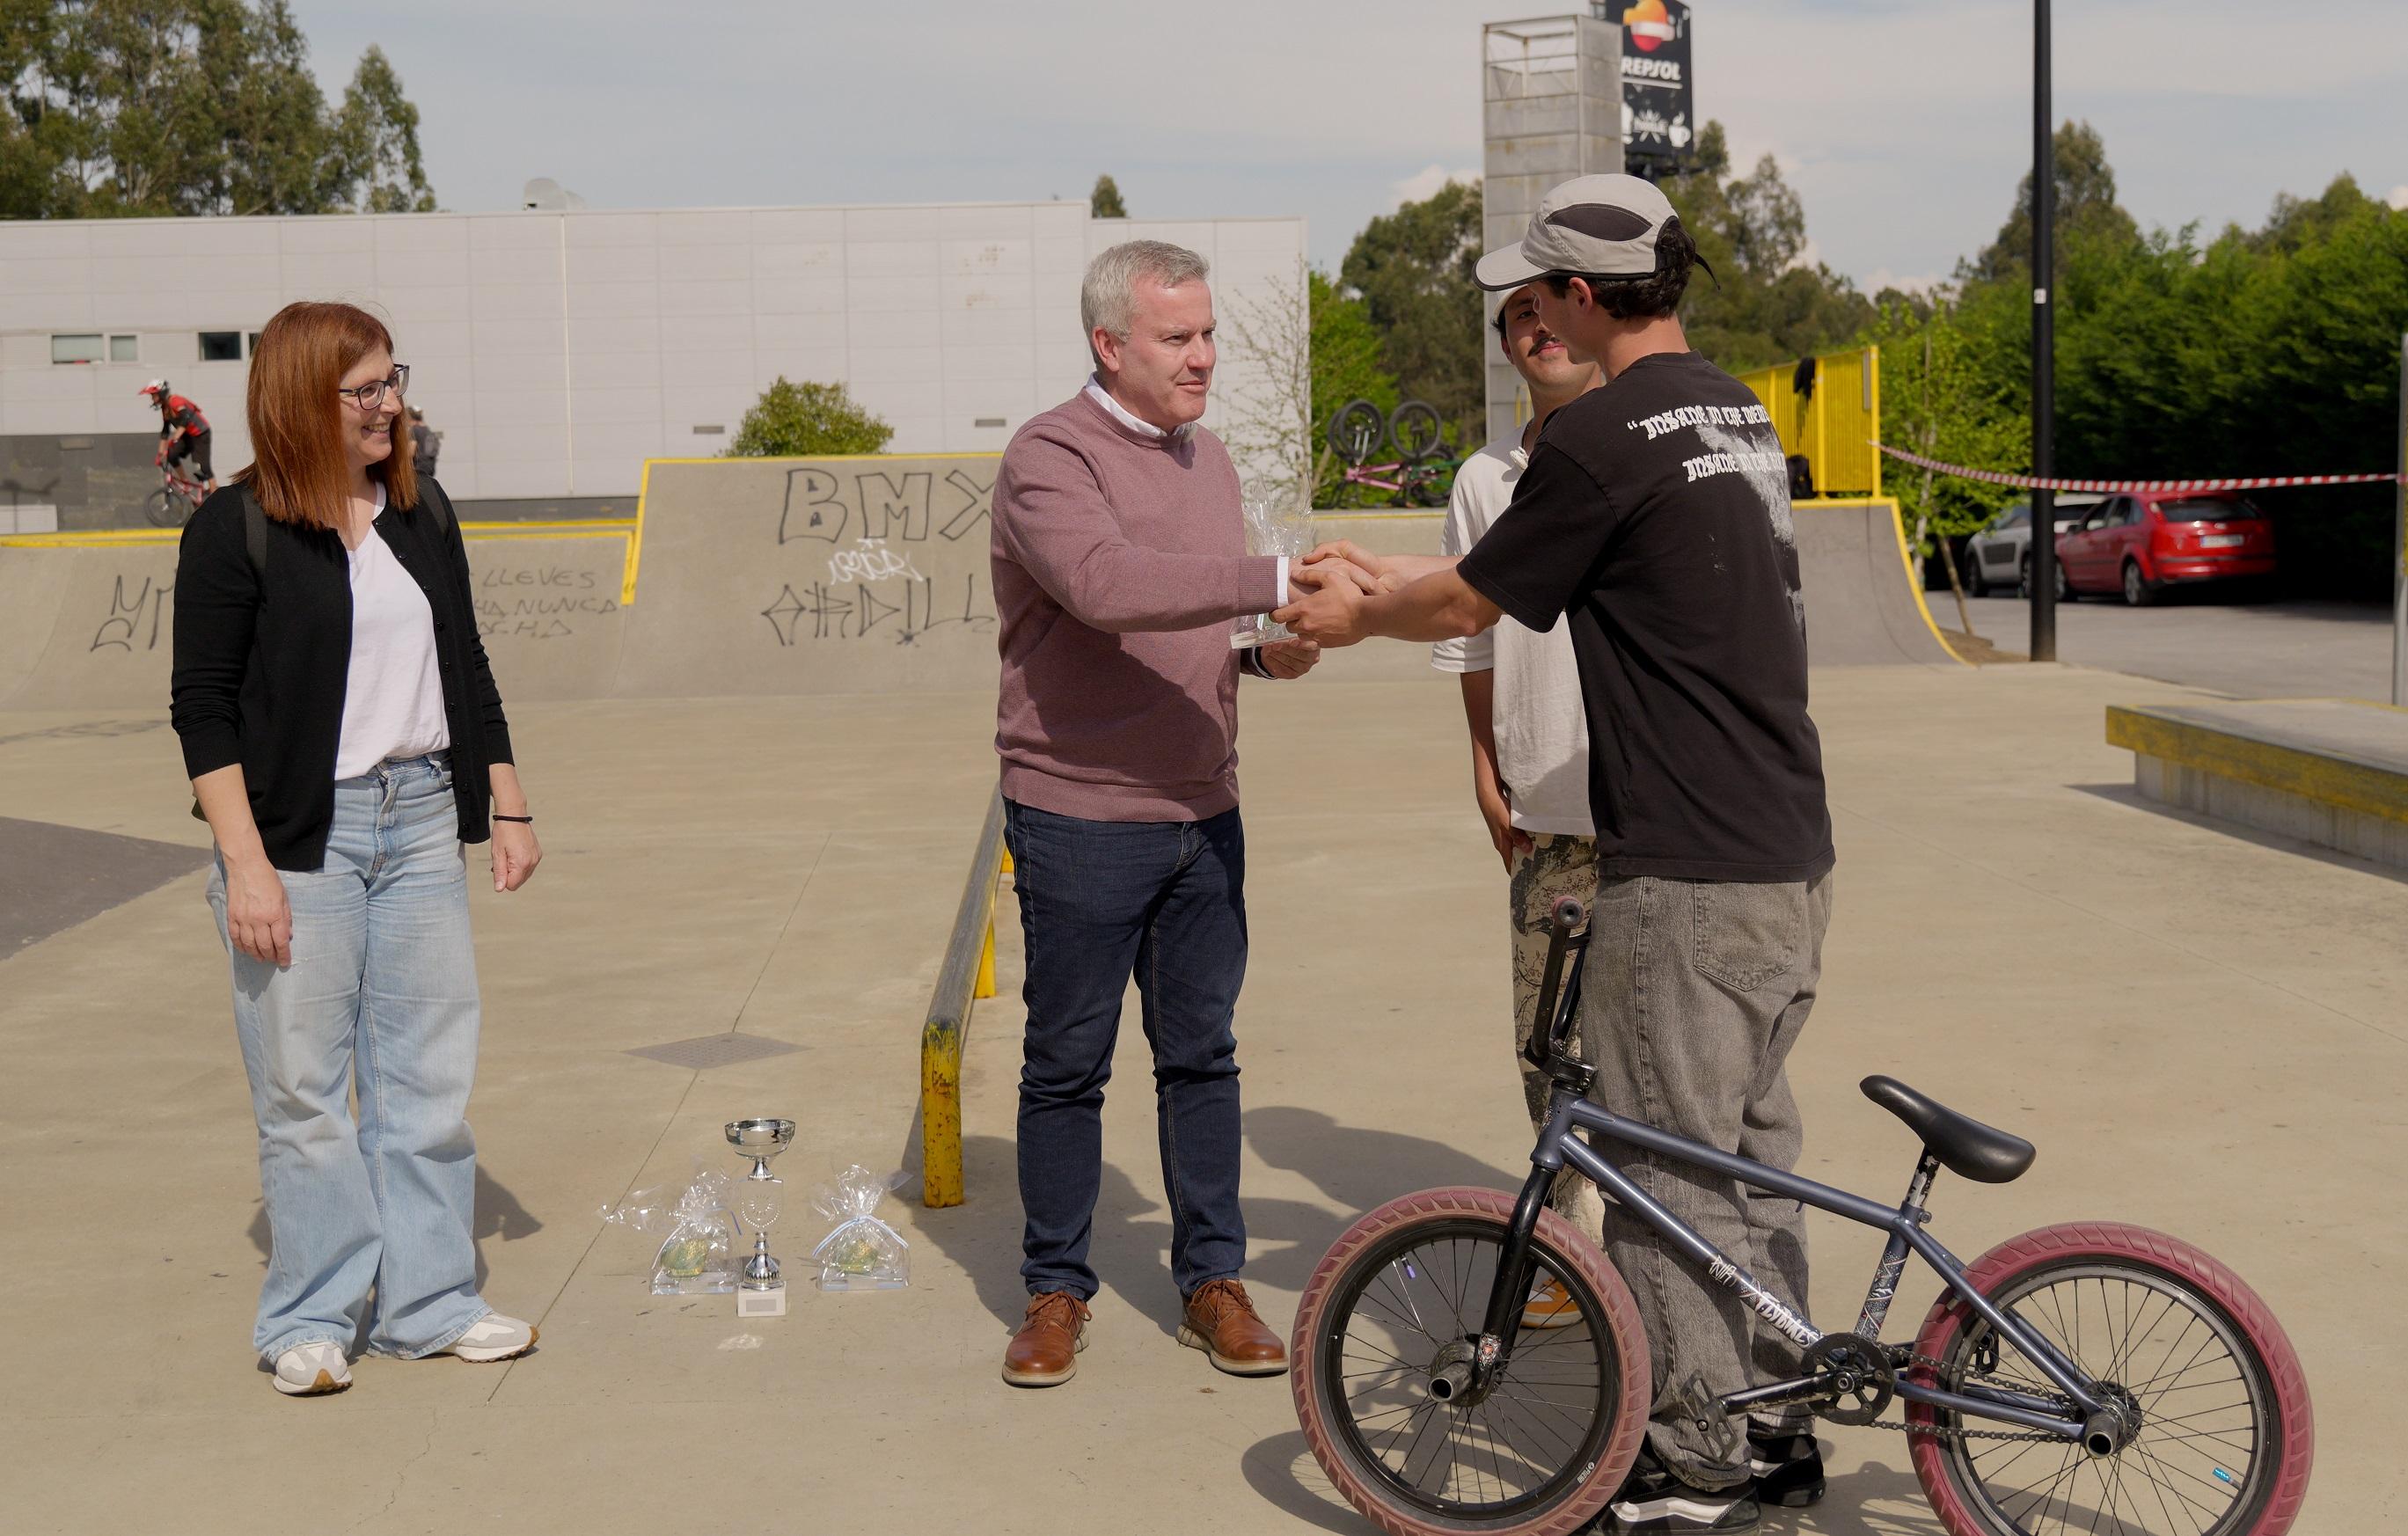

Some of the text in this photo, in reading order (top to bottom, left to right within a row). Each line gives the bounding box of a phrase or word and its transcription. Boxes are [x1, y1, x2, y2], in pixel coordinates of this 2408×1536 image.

[1621, 55, 1682, 81] REPSOL
[778, 468, 996, 545] BMX
[483, 566, 596, 589] LLEVES
[514, 596, 618, 618] NUNCA
